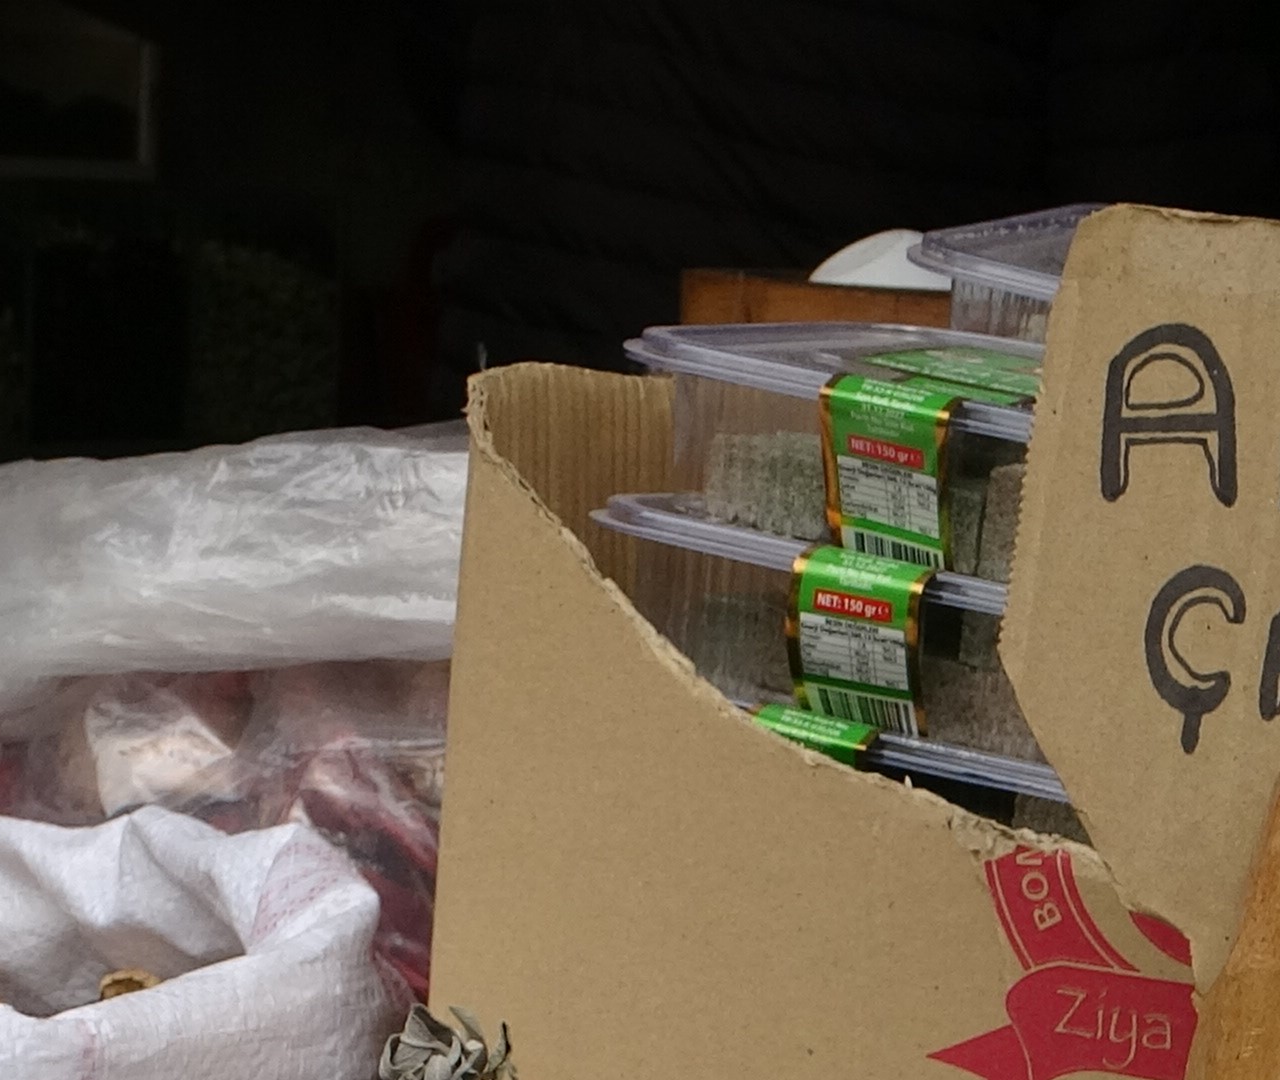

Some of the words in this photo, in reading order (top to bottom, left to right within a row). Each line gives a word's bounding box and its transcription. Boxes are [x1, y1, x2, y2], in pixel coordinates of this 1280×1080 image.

[876, 442, 896, 459] 150
[817, 592, 842, 609] NET:
[843, 598, 863, 614] 150
[864, 604, 877, 617] gr
[1055, 985, 1173, 1069] Ziya
